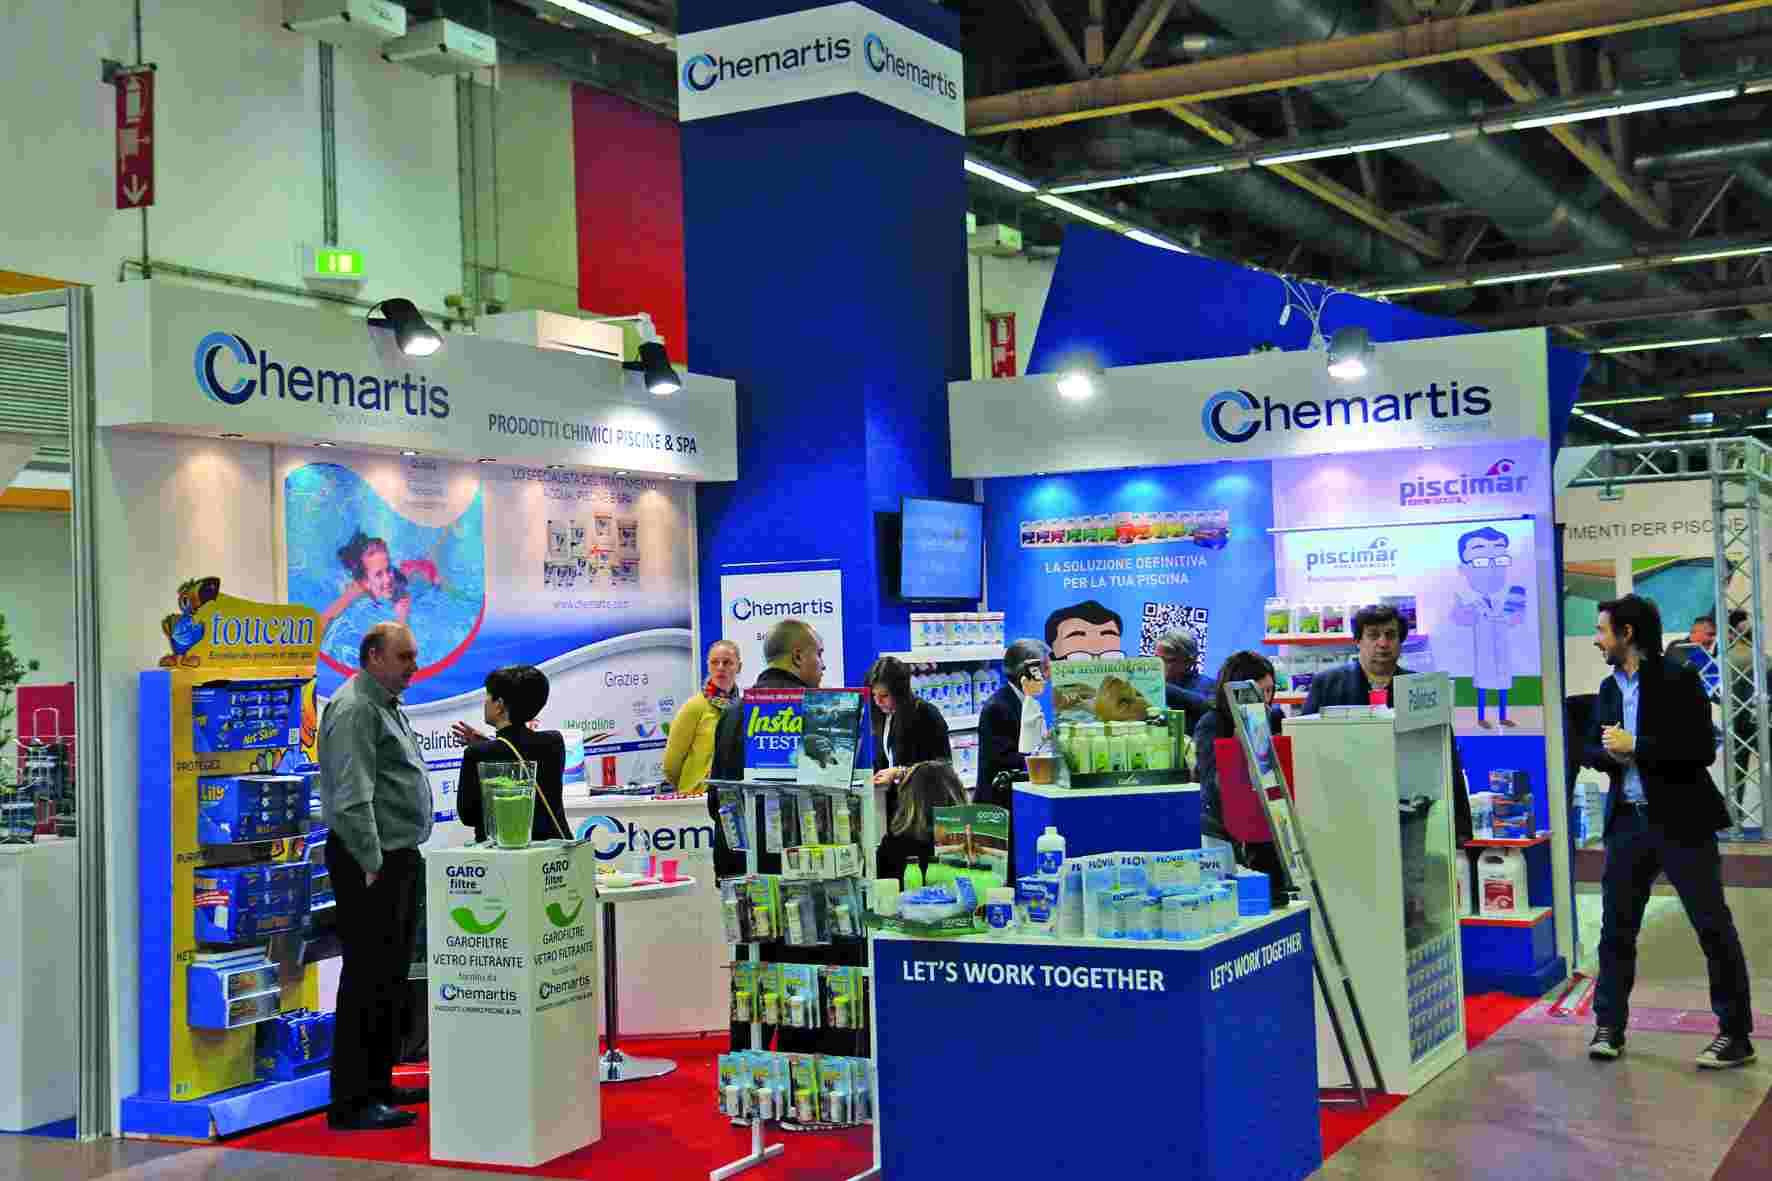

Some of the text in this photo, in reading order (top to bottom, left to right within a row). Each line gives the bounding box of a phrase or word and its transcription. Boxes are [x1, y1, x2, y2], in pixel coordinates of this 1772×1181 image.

[683, 36, 851, 92] Chemartis
[863, 32, 957, 100] Chemartis
[194, 331, 450, 418] Chemartis
[1201, 381, 1492, 444] Chemartis
[488, 413, 697, 454] PRODOTTI CHIMICI PISCINE & SPA
[1400, 474, 1529, 506] piscimar
[1631, 521, 1667, 537] PER
[1672, 517, 1744, 536] PISCE
[1044, 554, 1208, 574] LA SOLUZIONE DEFINITIVA
[1306, 548, 1398, 571] piscimar
[1063, 573, 1189, 590] PER LA TUA PISCINA
[732, 597, 834, 621] Chemartis
[209, 611, 316, 647] toucan
[604, 670, 649, 689] Grazie a
[747, 706, 803, 737] Insta
[754, 736, 801, 750] TEST
[446, 865, 486, 878] GARO
[542, 859, 569, 875] GARO
[449, 878, 478, 889] filtre
[446, 935, 509, 949] GAROFILTRE
[433, 953, 523, 968] VETRO FILTRANTE
[1209, 933, 1302, 991] LET'S WORK TOGETHER
[902, 960, 1166, 992] LET'S WORK TOGETHER
[440, 984, 518, 1001] Chemartis
